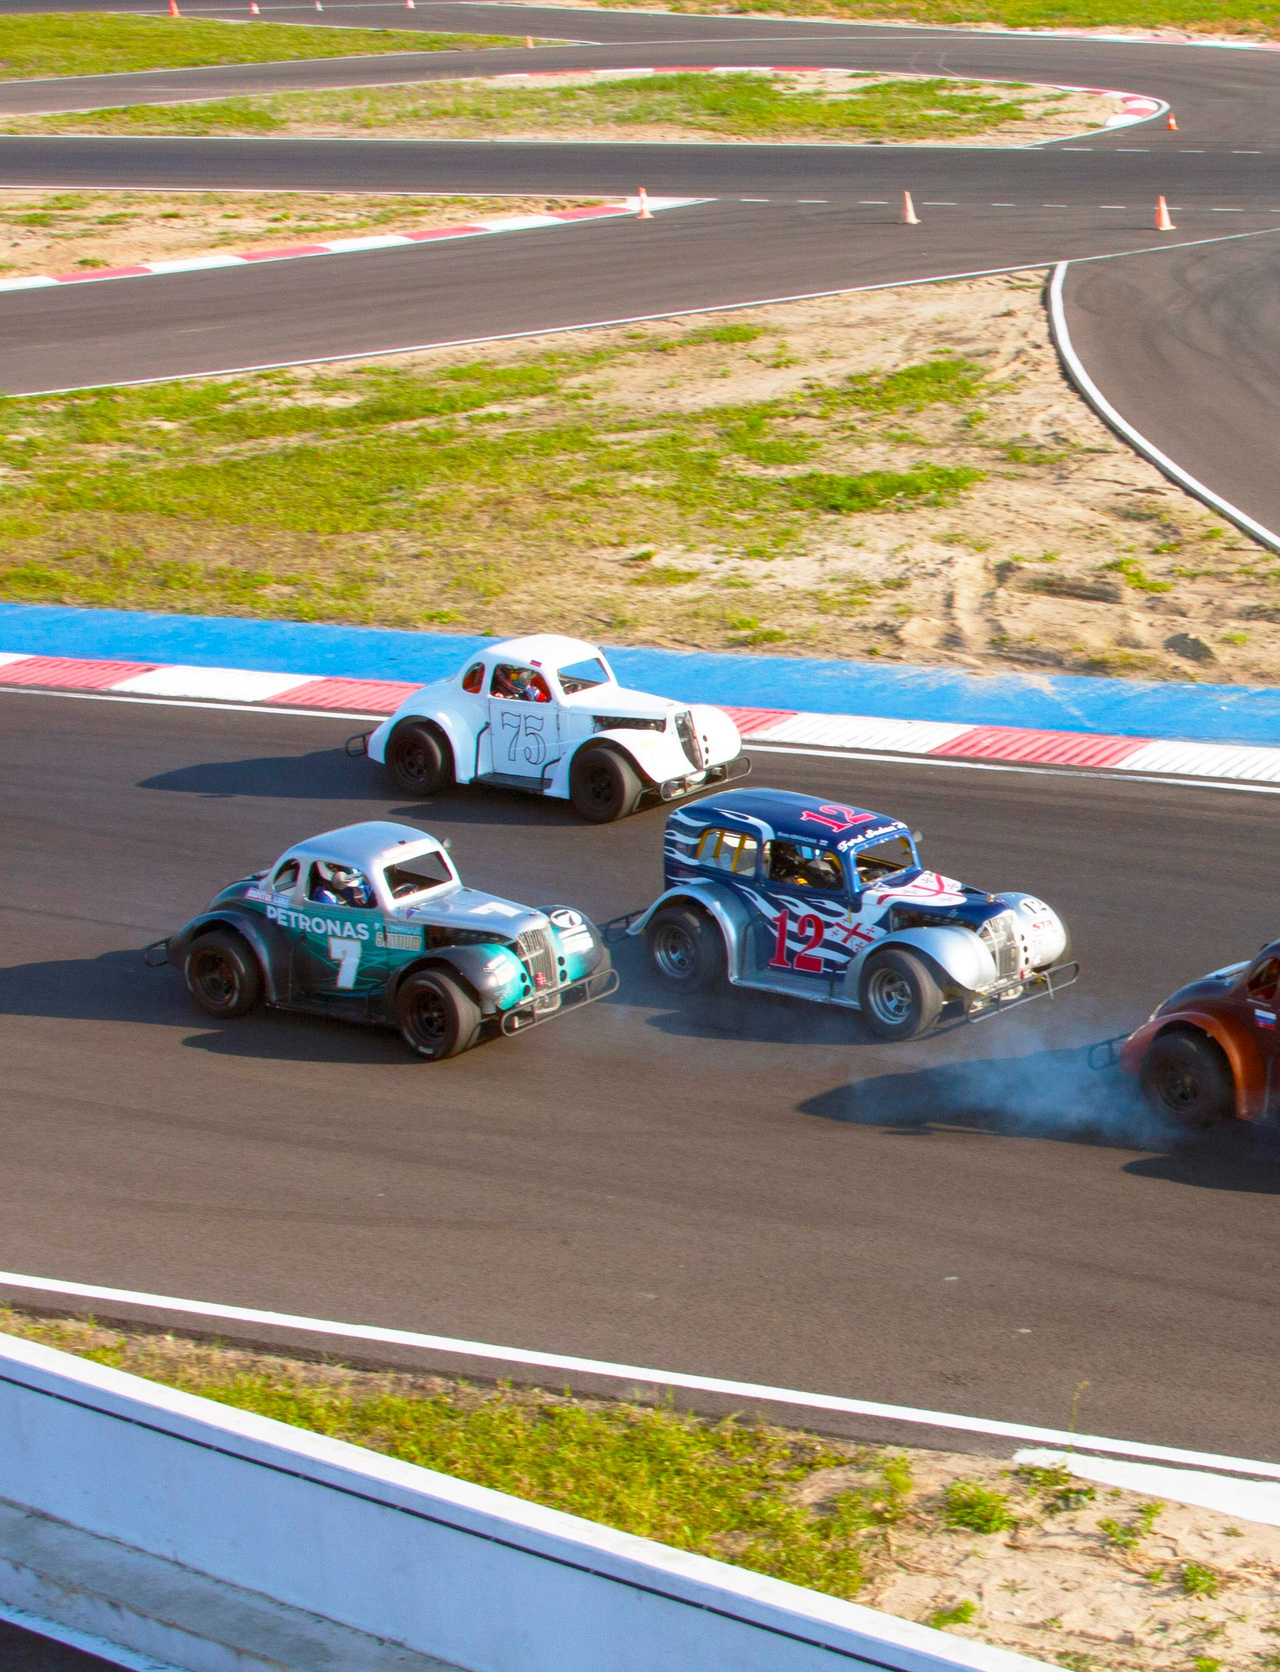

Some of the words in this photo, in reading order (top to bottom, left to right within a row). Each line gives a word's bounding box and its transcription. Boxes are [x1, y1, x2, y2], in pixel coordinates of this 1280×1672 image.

[501, 711, 546, 765] 75
[800, 804, 878, 833] 12
[266, 905, 370, 941] PETRONAS
[552, 910, 576, 926] 7
[328, 936, 362, 989] 7
[768, 909, 825, 973] 12
